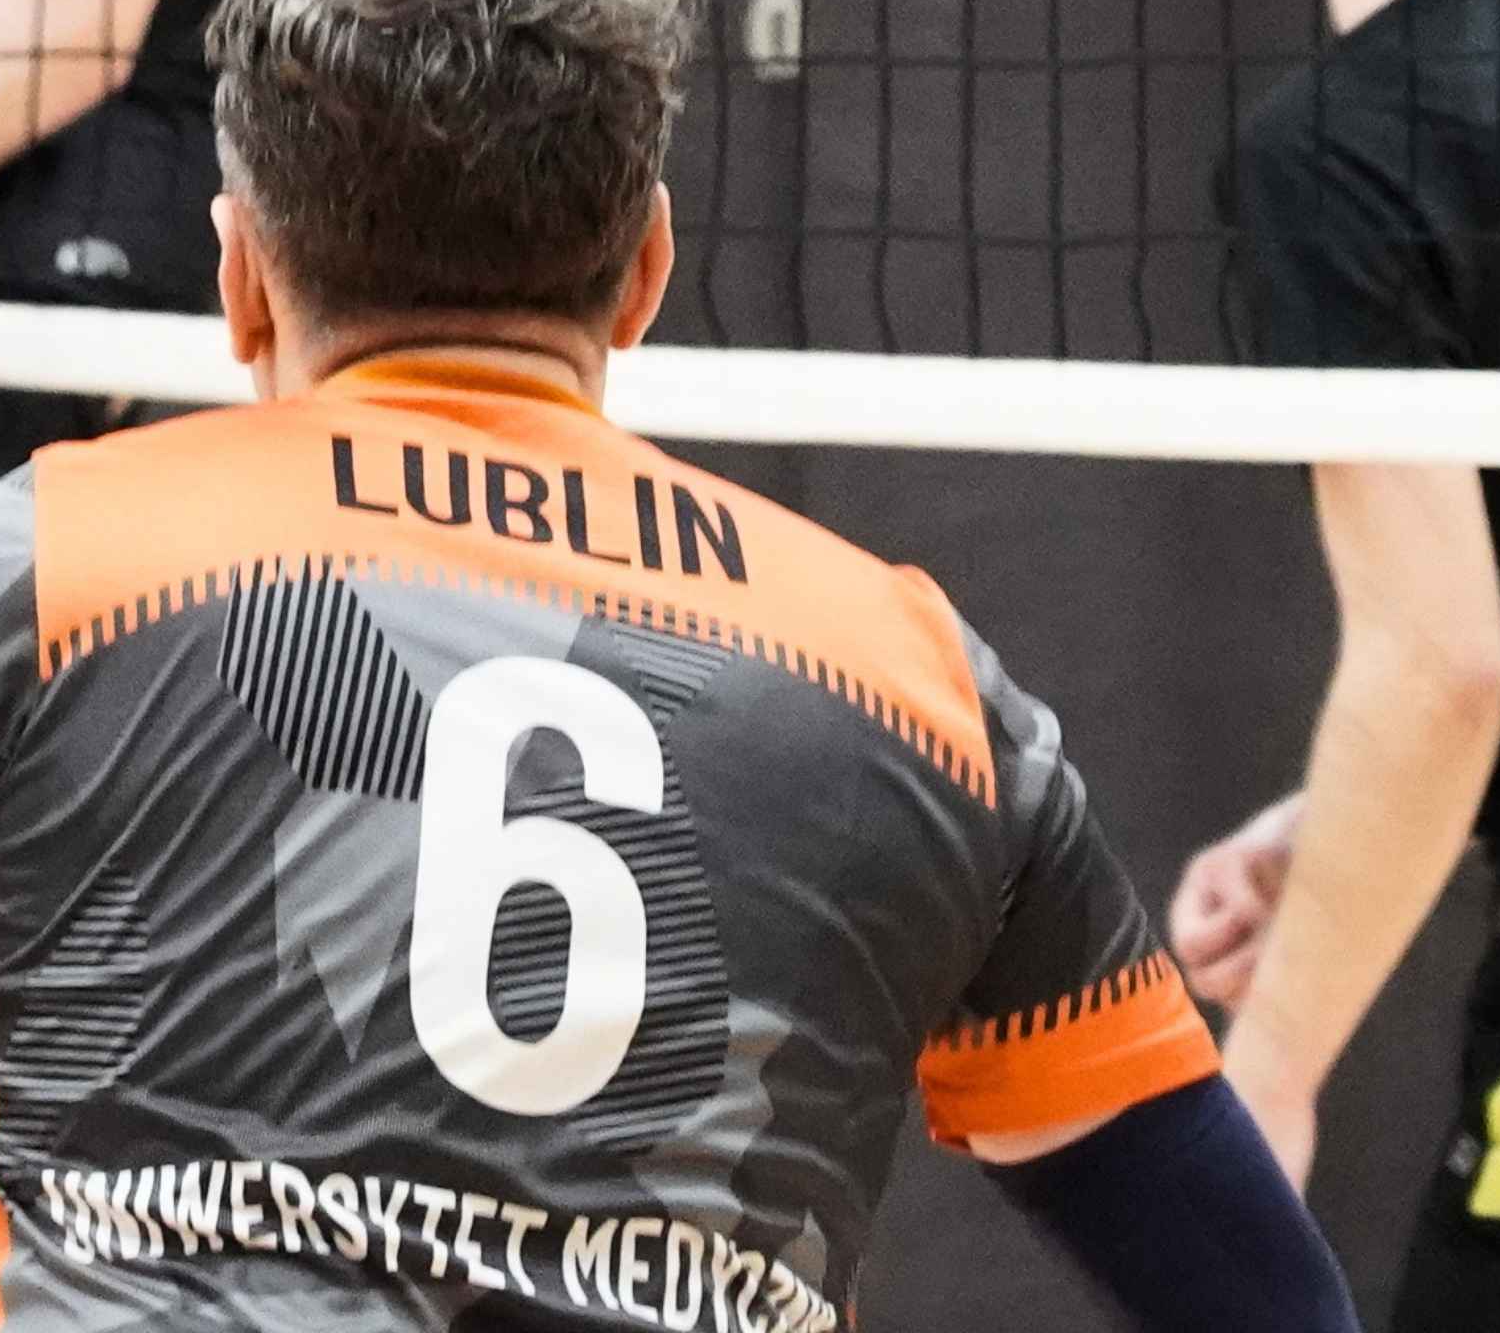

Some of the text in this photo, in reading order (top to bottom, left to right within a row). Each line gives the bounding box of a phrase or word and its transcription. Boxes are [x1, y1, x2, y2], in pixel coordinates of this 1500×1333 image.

[330, 434, 749, 585] LUBLIN
[409, 655, 665, 1116] 6
[40, 1159, 549, 1299] UNIWERSYTET
